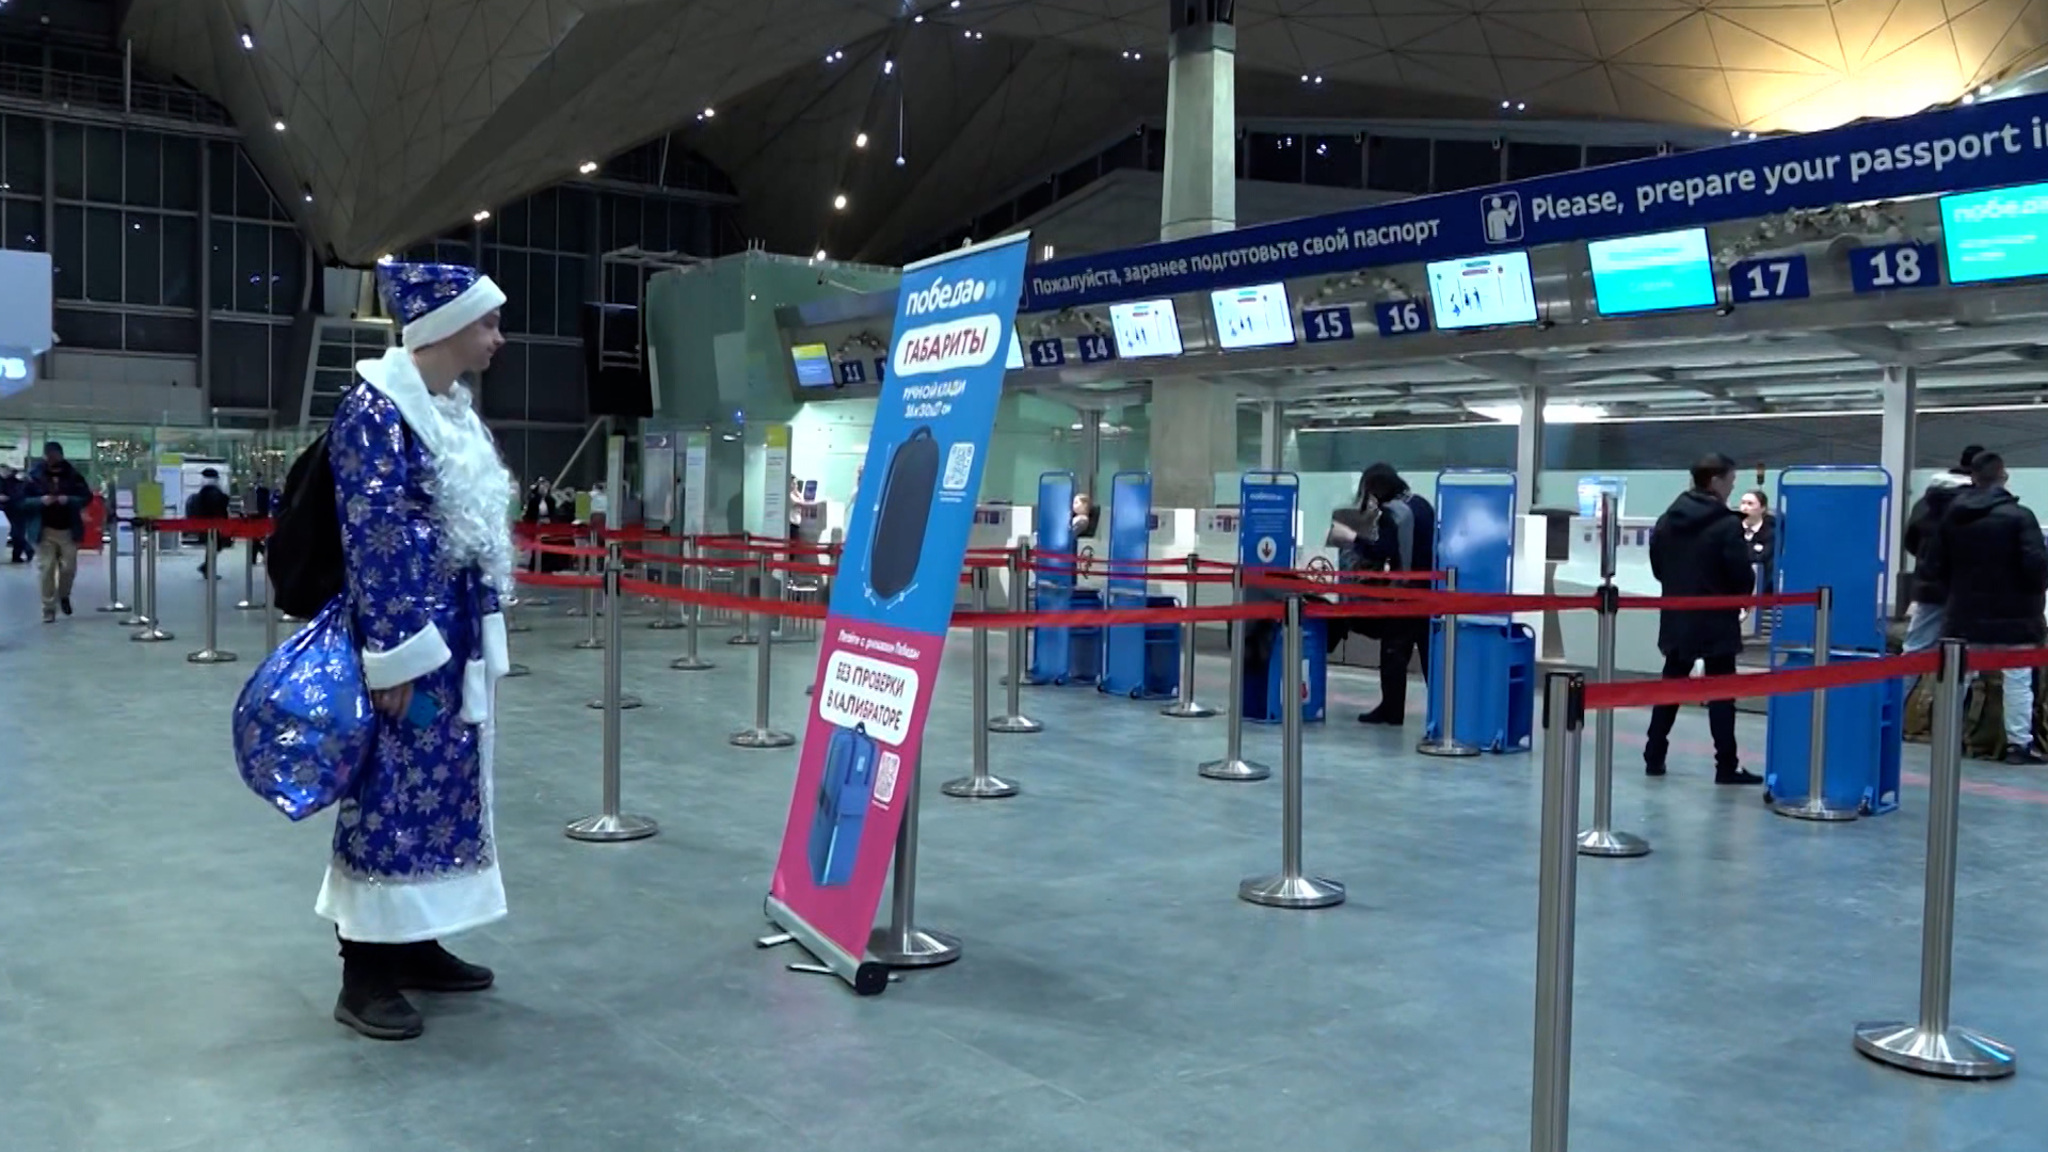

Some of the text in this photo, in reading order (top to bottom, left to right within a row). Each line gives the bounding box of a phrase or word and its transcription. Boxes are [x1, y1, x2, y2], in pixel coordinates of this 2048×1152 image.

[1531, 115, 2048, 223] Please, prepare your passport i
[1032, 218, 1441, 297] Пожалуйста, заранее подготовьте свой паспорт
[1869, 247, 1922, 288] 18
[905, 275, 975, 317] победа
[1746, 262, 1791, 299] 17
[1314, 311, 1344, 340] 15
[1387, 302, 1421, 333] 16
[903, 326, 989, 365] ГАБАРИТЫ
[1037, 342, 1058, 364] 13
[1085, 336, 1108, 360] 14
[845, 363, 861, 382] 11
[836, 661, 905, 698] БЕЗ ПРОВЕРКИ
[834, 692, 903, 731] КАЛИБРАТОРЕ
